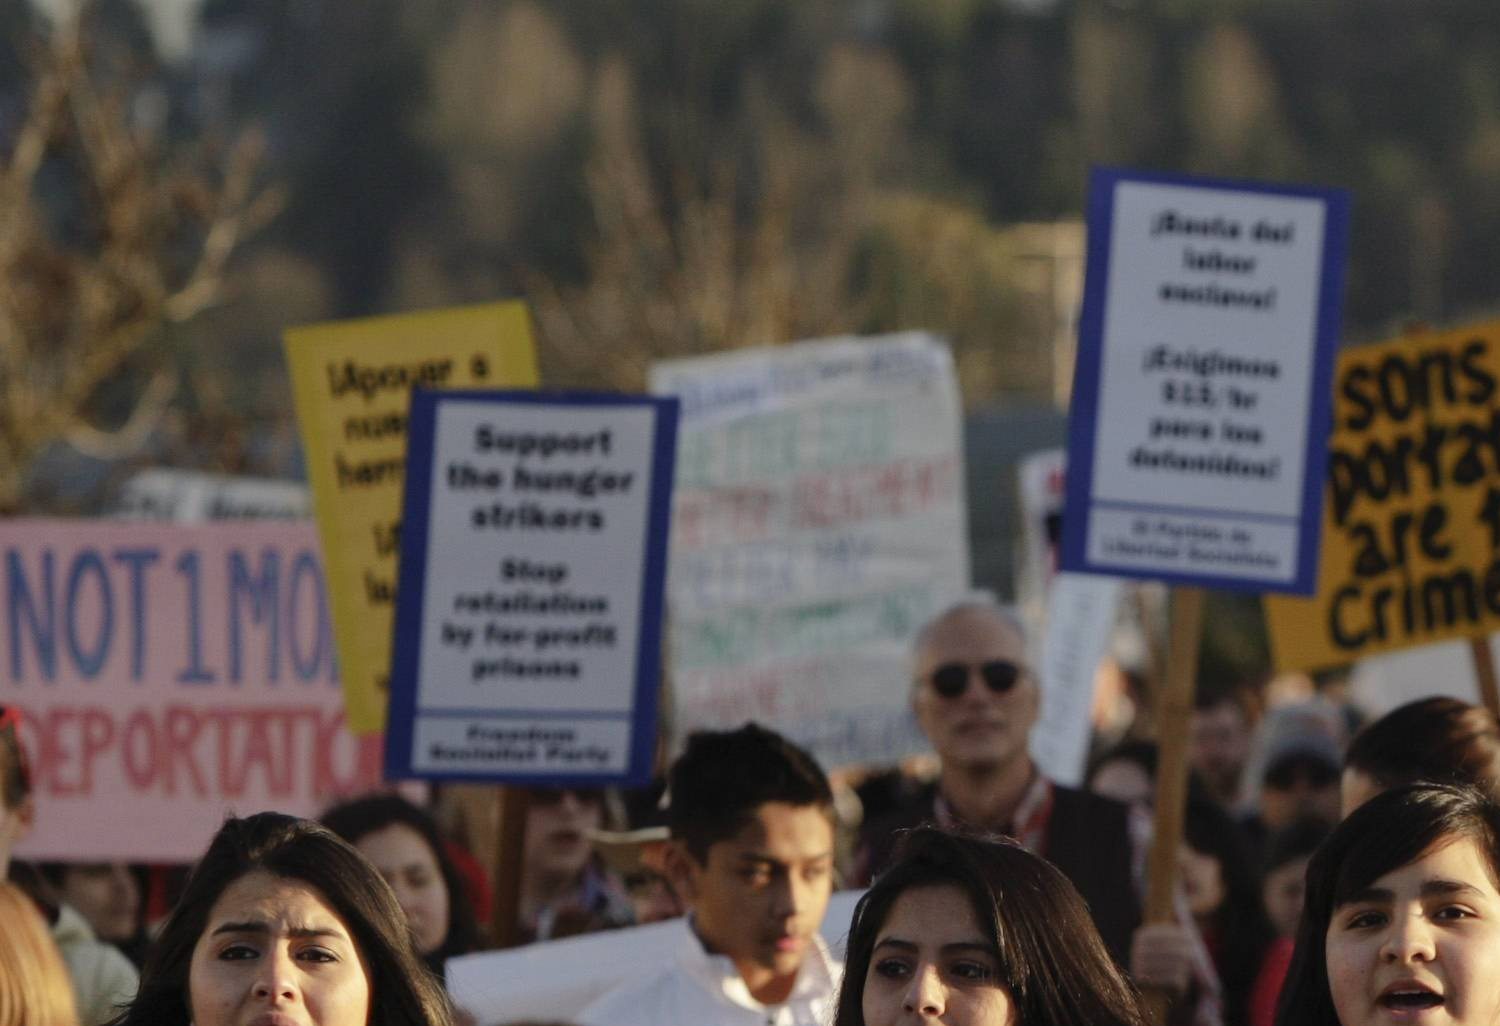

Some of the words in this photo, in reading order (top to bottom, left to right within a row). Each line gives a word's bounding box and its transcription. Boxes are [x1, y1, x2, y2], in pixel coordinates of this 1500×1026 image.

[1342, 341, 1498, 432] sons
[473, 422, 614, 459] Support
[446, 463, 504, 492] the
[513, 465, 635, 501] hunger
[471, 503, 605, 531] strikers
[1350, 504, 1452, 578] are
[501, 557, 568, 584] Stop
[5, 545, 161, 685] NOT
[439, 621, 474, 651] by
[470, 657, 581, 683] prisons
